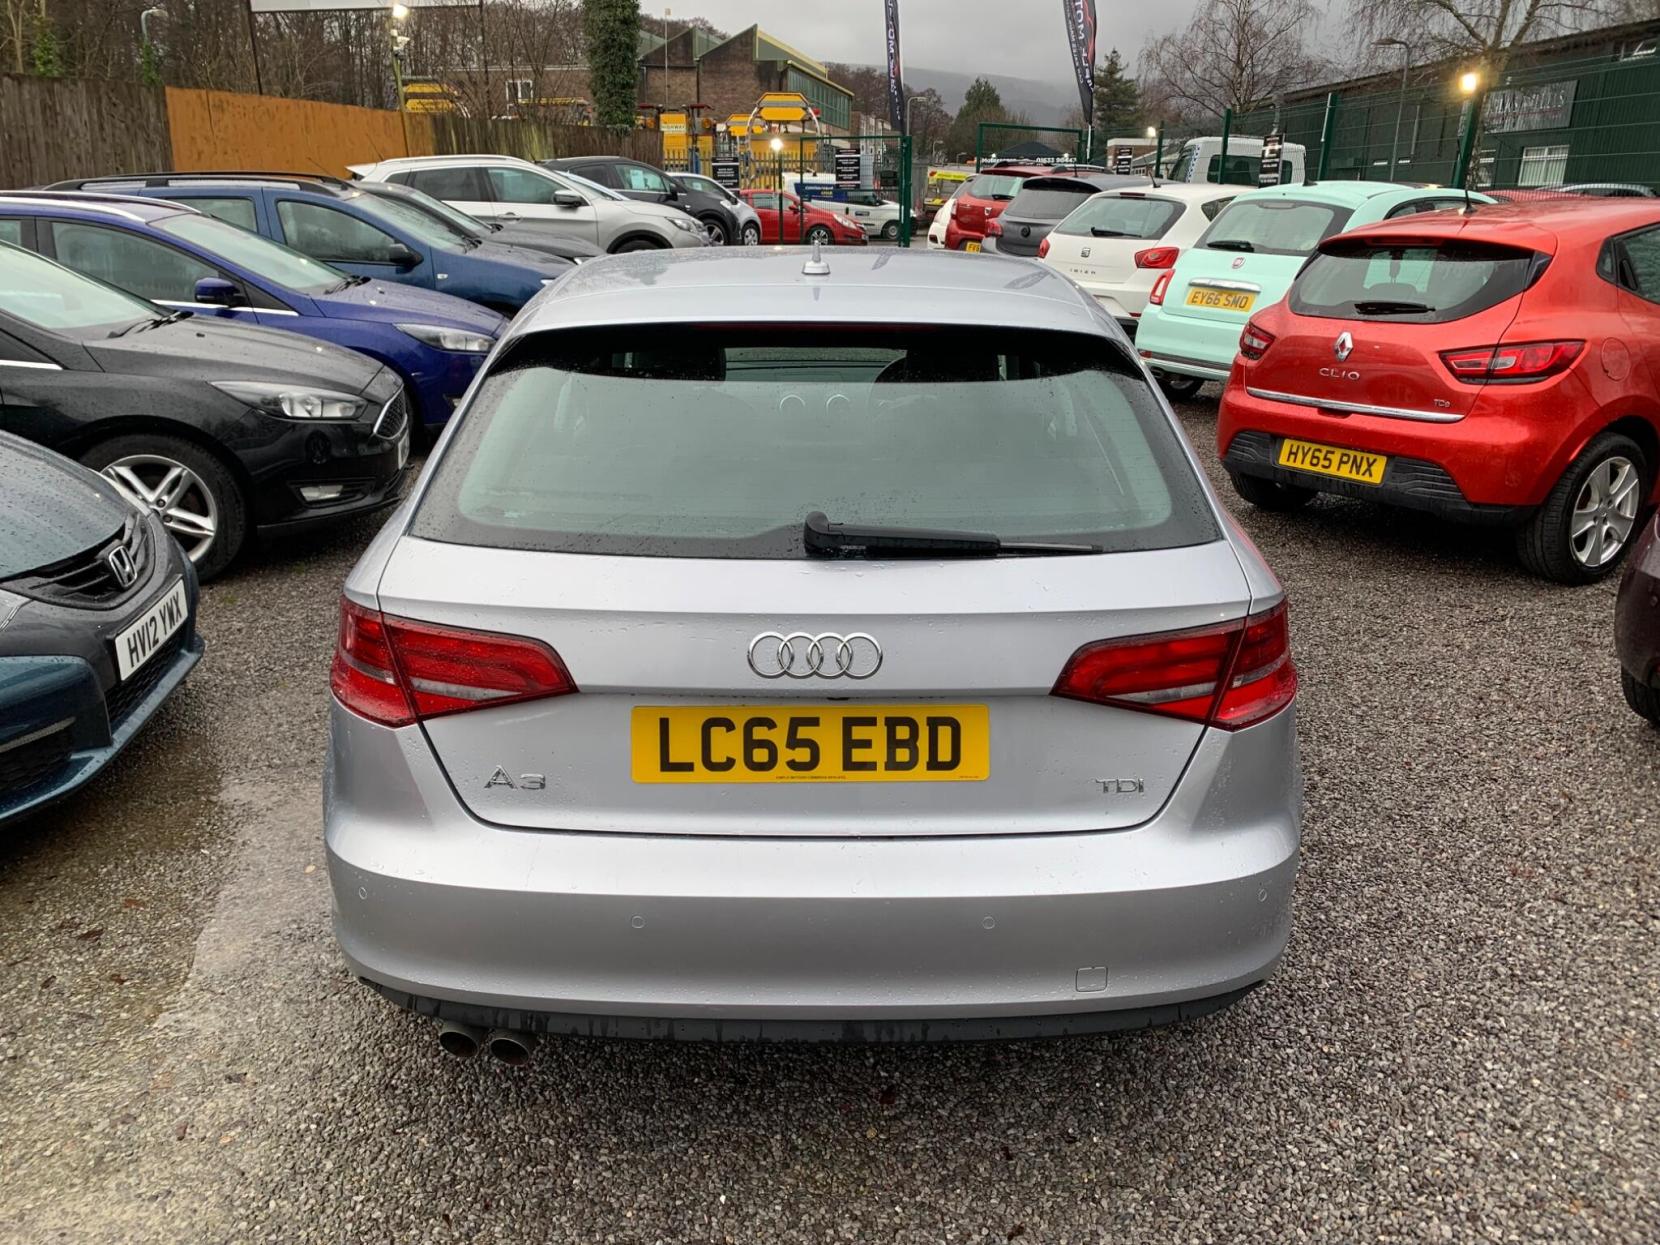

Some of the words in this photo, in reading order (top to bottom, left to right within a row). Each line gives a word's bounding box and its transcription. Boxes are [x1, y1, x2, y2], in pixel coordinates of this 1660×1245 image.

[1191, 290, 1221, 306] EY66
[1224, 293, 1250, 309] SMO
[1319, 367, 1361, 381] CLIO
[1286, 444, 1337, 470] HY65
[1336, 453, 1378, 478] PNX
[127, 615, 160, 668] HV12
[159, 591, 182, 636] YWX
[659, 716, 821, 773] LC65
[841, 715, 963, 772] EBD
[484, 764, 546, 790] A3
[1095, 778, 1145, 794] TDI
